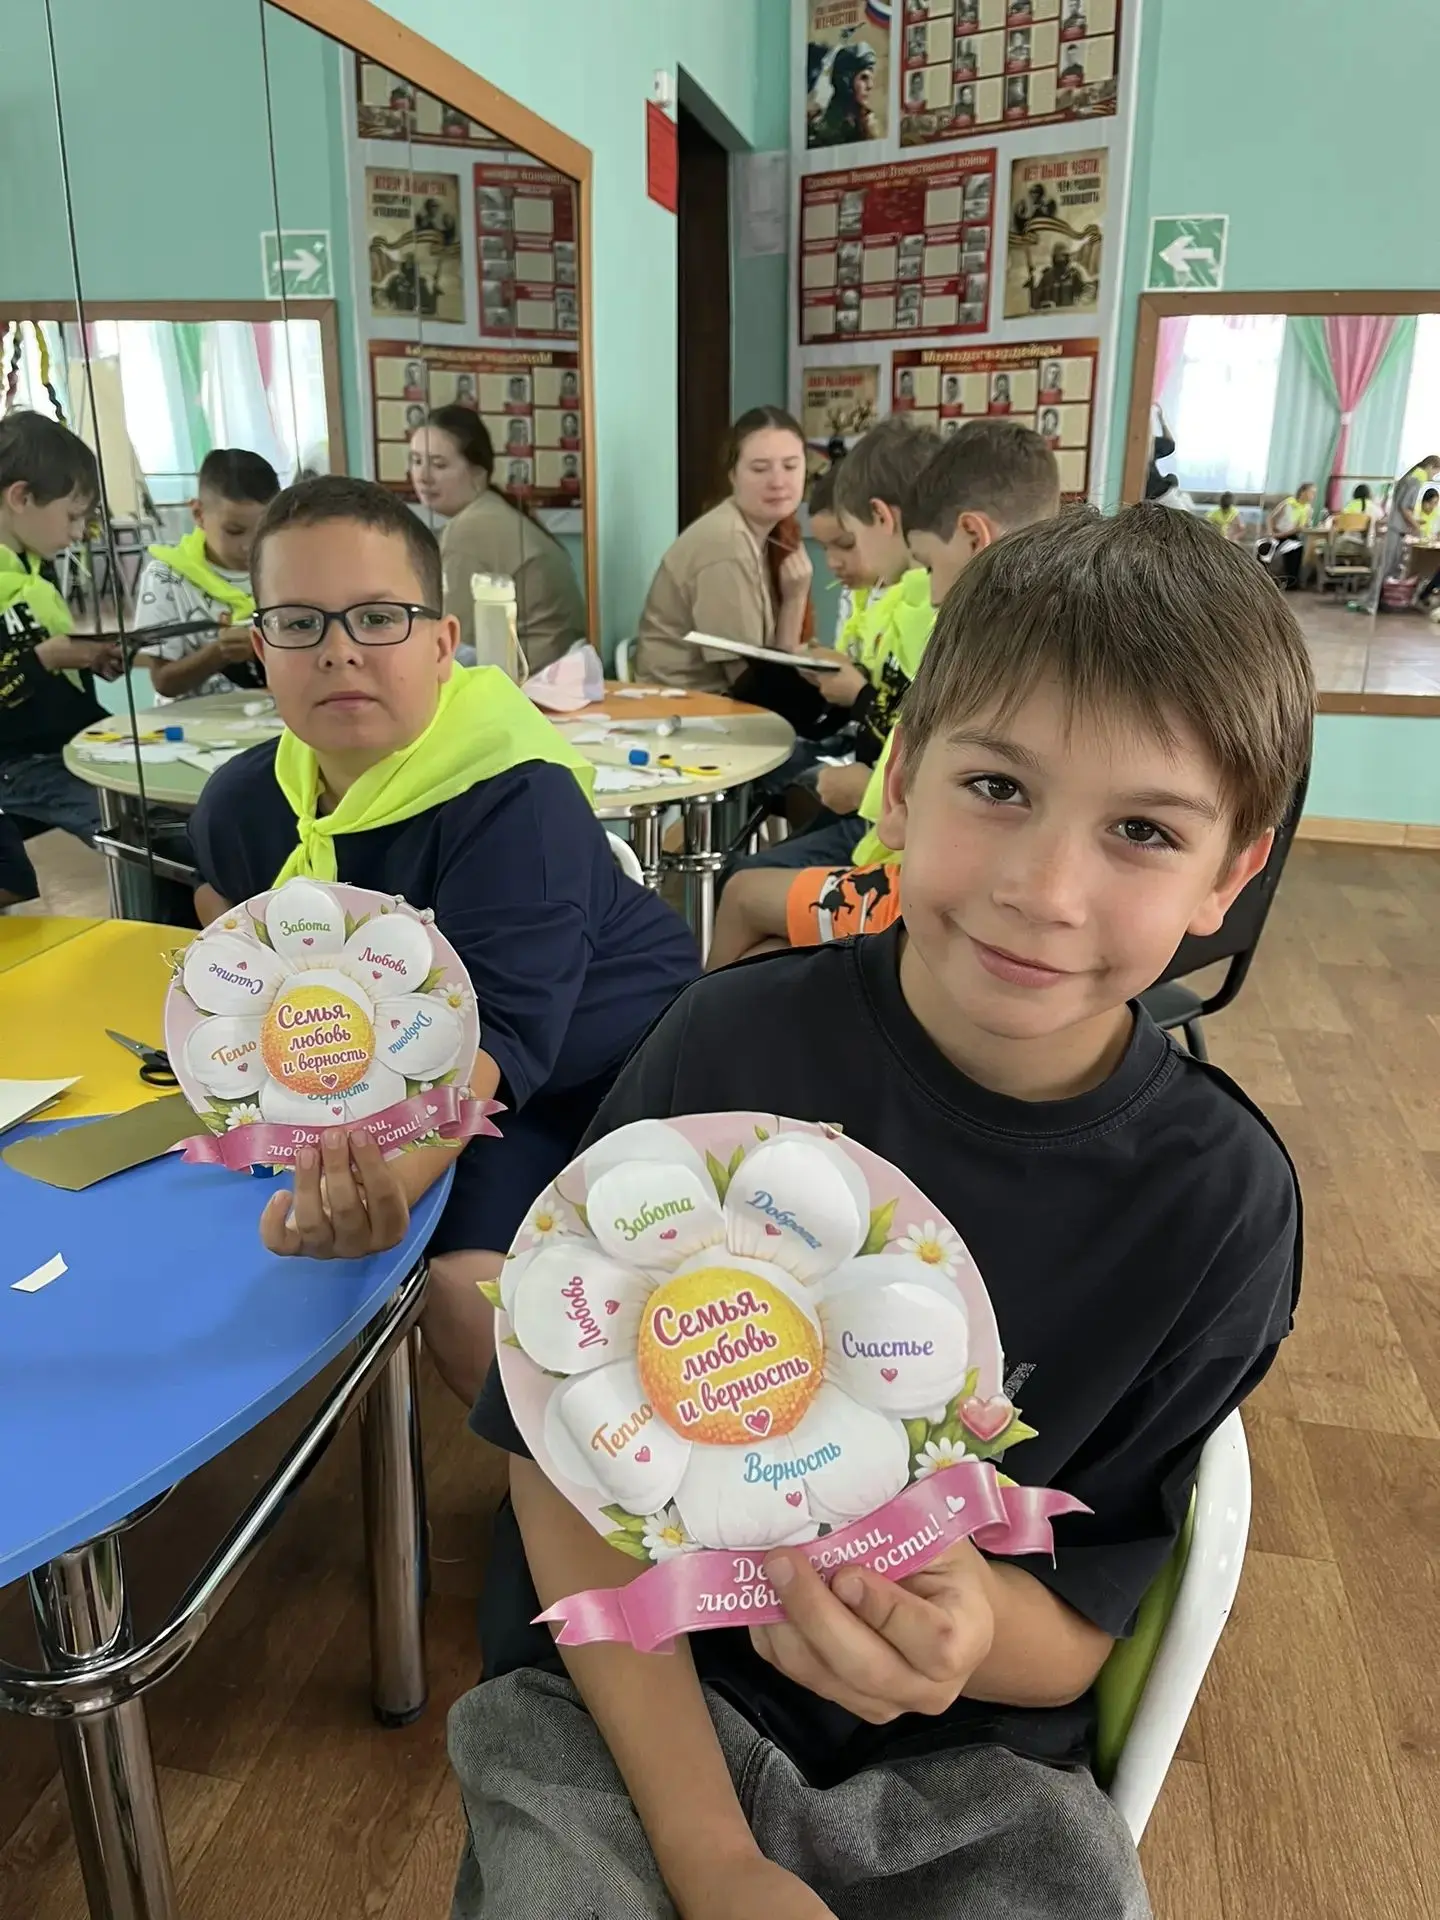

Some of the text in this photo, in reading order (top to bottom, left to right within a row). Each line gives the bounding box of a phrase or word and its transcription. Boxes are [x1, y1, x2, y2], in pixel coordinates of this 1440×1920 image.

[280, 918, 331, 936] Забота
[208, 963, 264, 995] Счастье
[358, 947, 408, 975] Любовь
[278, 1004, 351, 1029] Семья,
[289, 1026, 351, 1050] любовь
[388, 1010, 432, 1054] Доброта
[211, 1040, 257, 1066] Тепло
[283, 1048, 366, 1075] и верность
[614, 1196, 695, 1242] Забота
[746, 1190, 822, 1249] Доброта
[561, 1276, 608, 1348] Любовь
[653, 1290, 769, 1346] Семья,
[682, 1323, 777, 1381] любовь
[842, 1331, 934, 1358] Счастье
[680, 1358, 810, 1423] и верность
[592, 1403, 653, 1459] Тепло
[744, 1442, 841, 1490] Верность
[809, 1528, 893, 1571] семьи,
